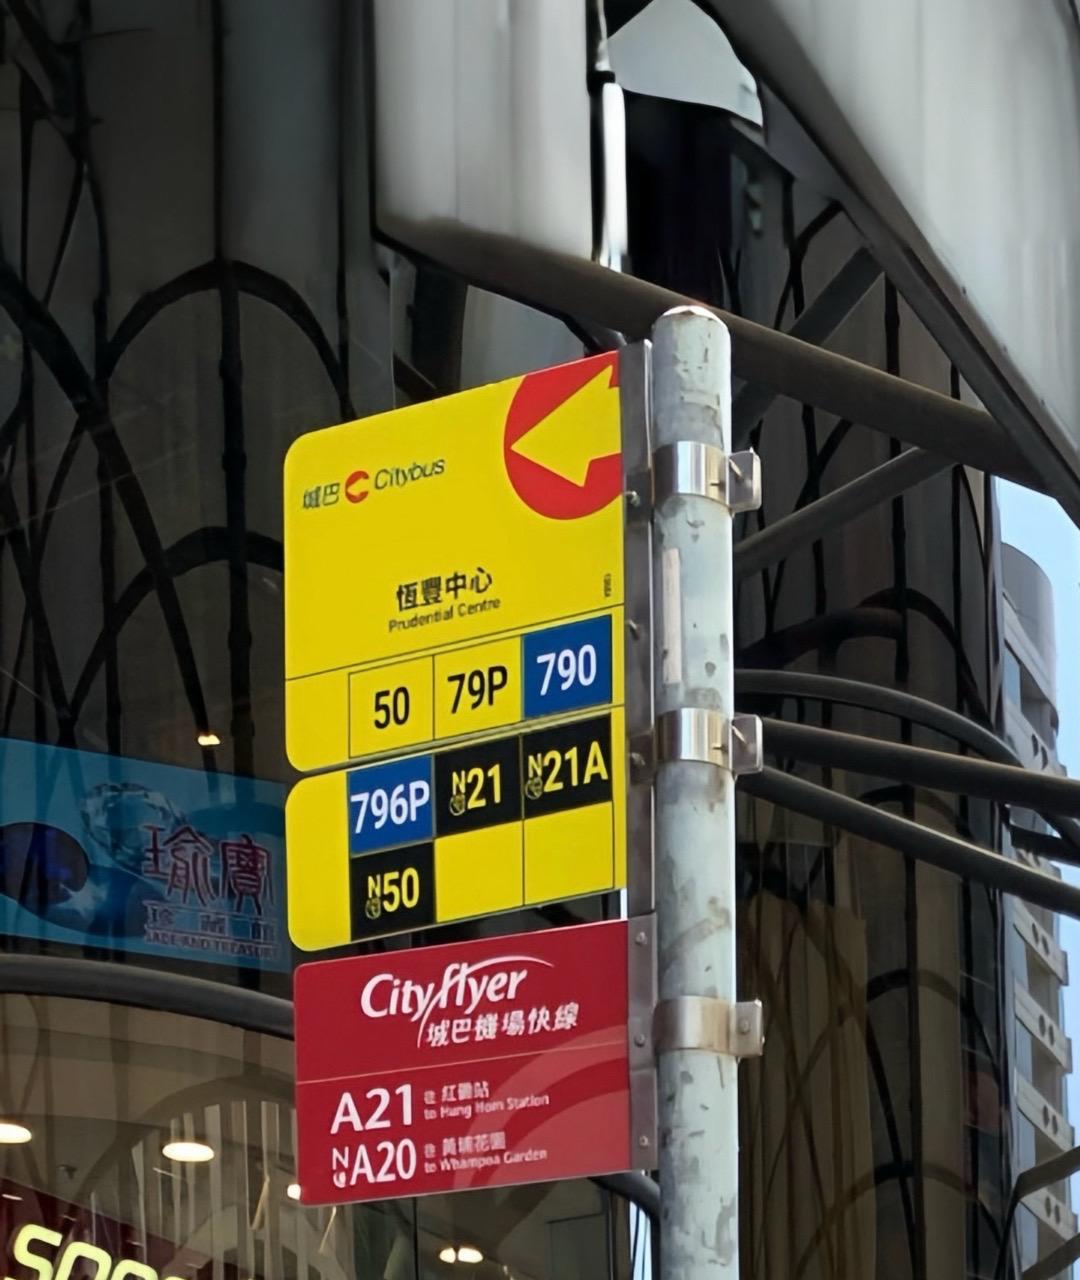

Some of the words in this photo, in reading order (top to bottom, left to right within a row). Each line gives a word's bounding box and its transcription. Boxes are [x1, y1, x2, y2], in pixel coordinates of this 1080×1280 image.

[374, 459, 445, 490] Citybus
[388, 605, 454, 633] Prudential
[457, 598, 501, 617] Centre
[373, 686, 410, 729] 50
[447, 665, 508, 715] 79P
[536, 644, 597, 696] 790
[350, 779, 430, 834] 796P
[452, 763, 501, 810] N21
[528, 740, 609, 793] N21A
[368, 866, 420, 913] N50
[330, 1083, 412, 1134] A21
